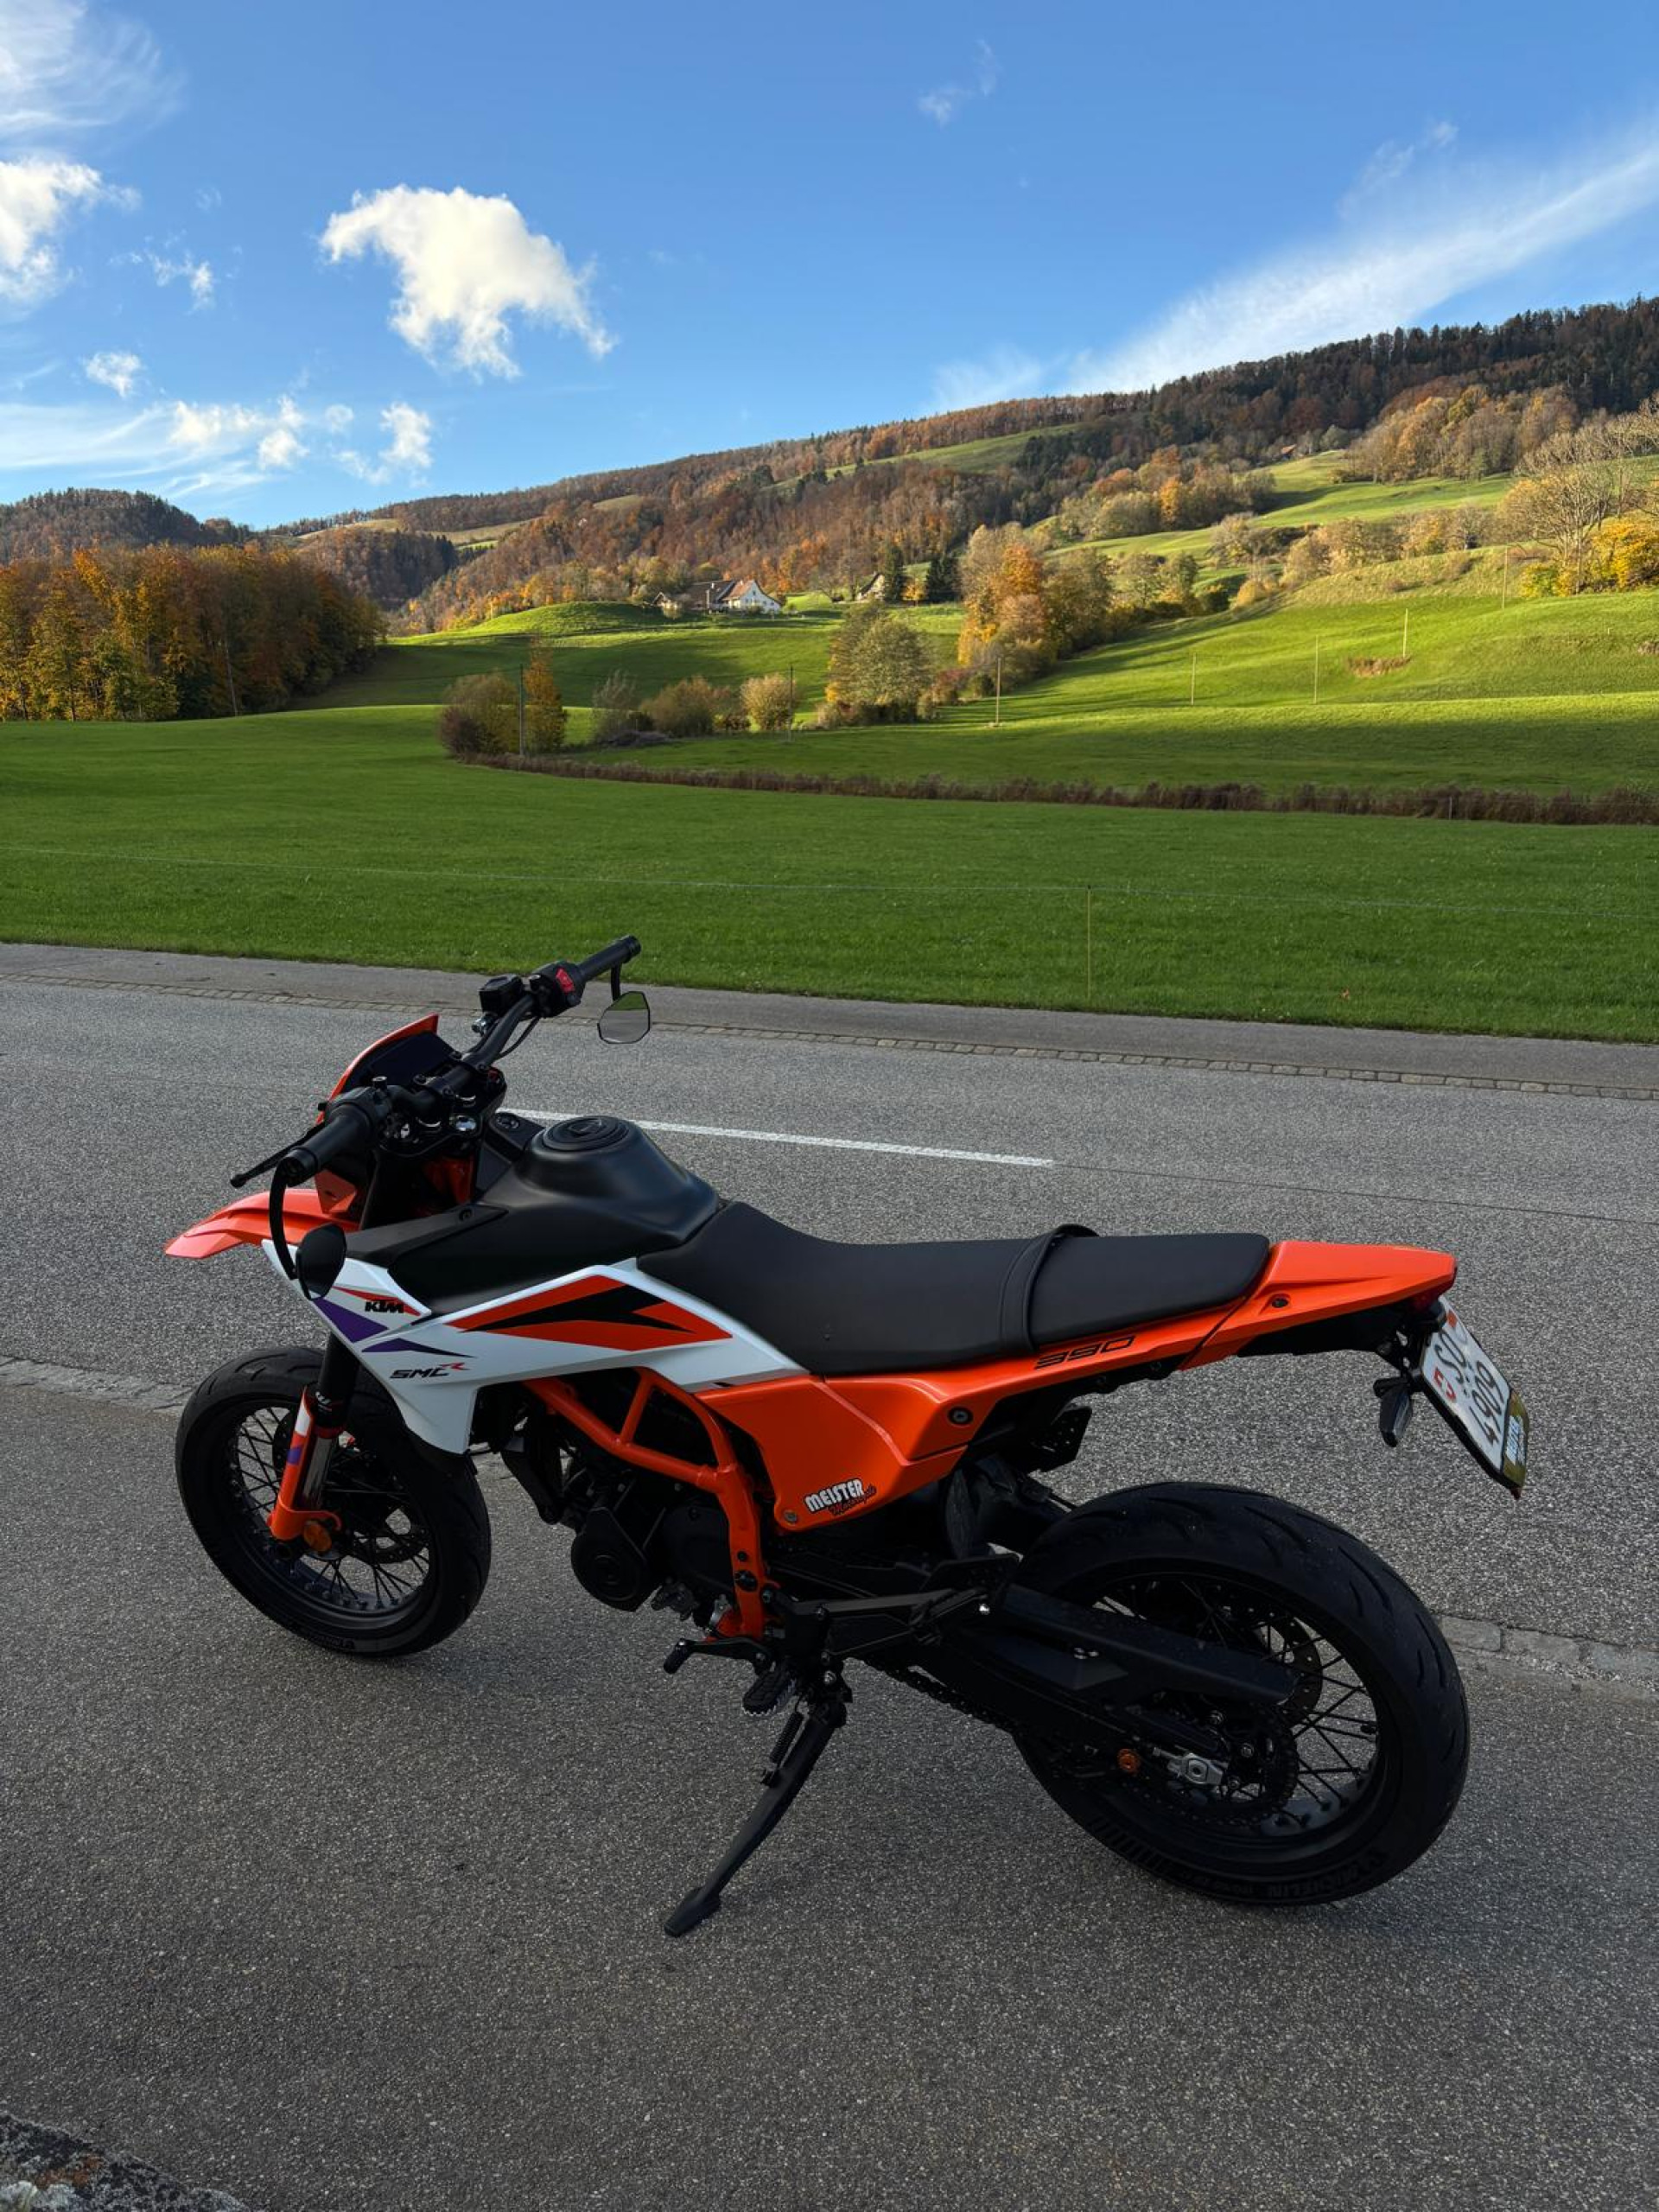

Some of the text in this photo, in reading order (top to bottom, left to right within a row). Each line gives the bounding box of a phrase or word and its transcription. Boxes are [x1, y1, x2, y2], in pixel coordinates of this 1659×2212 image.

[365, 1300, 404, 1313] KTM
[1034, 1336, 1136, 1370] 390
[1433, 1329, 1467, 1385] SO
[1469, 1360, 1505, 1446] 4909
[804, 1478, 865, 1513] MEISTER
